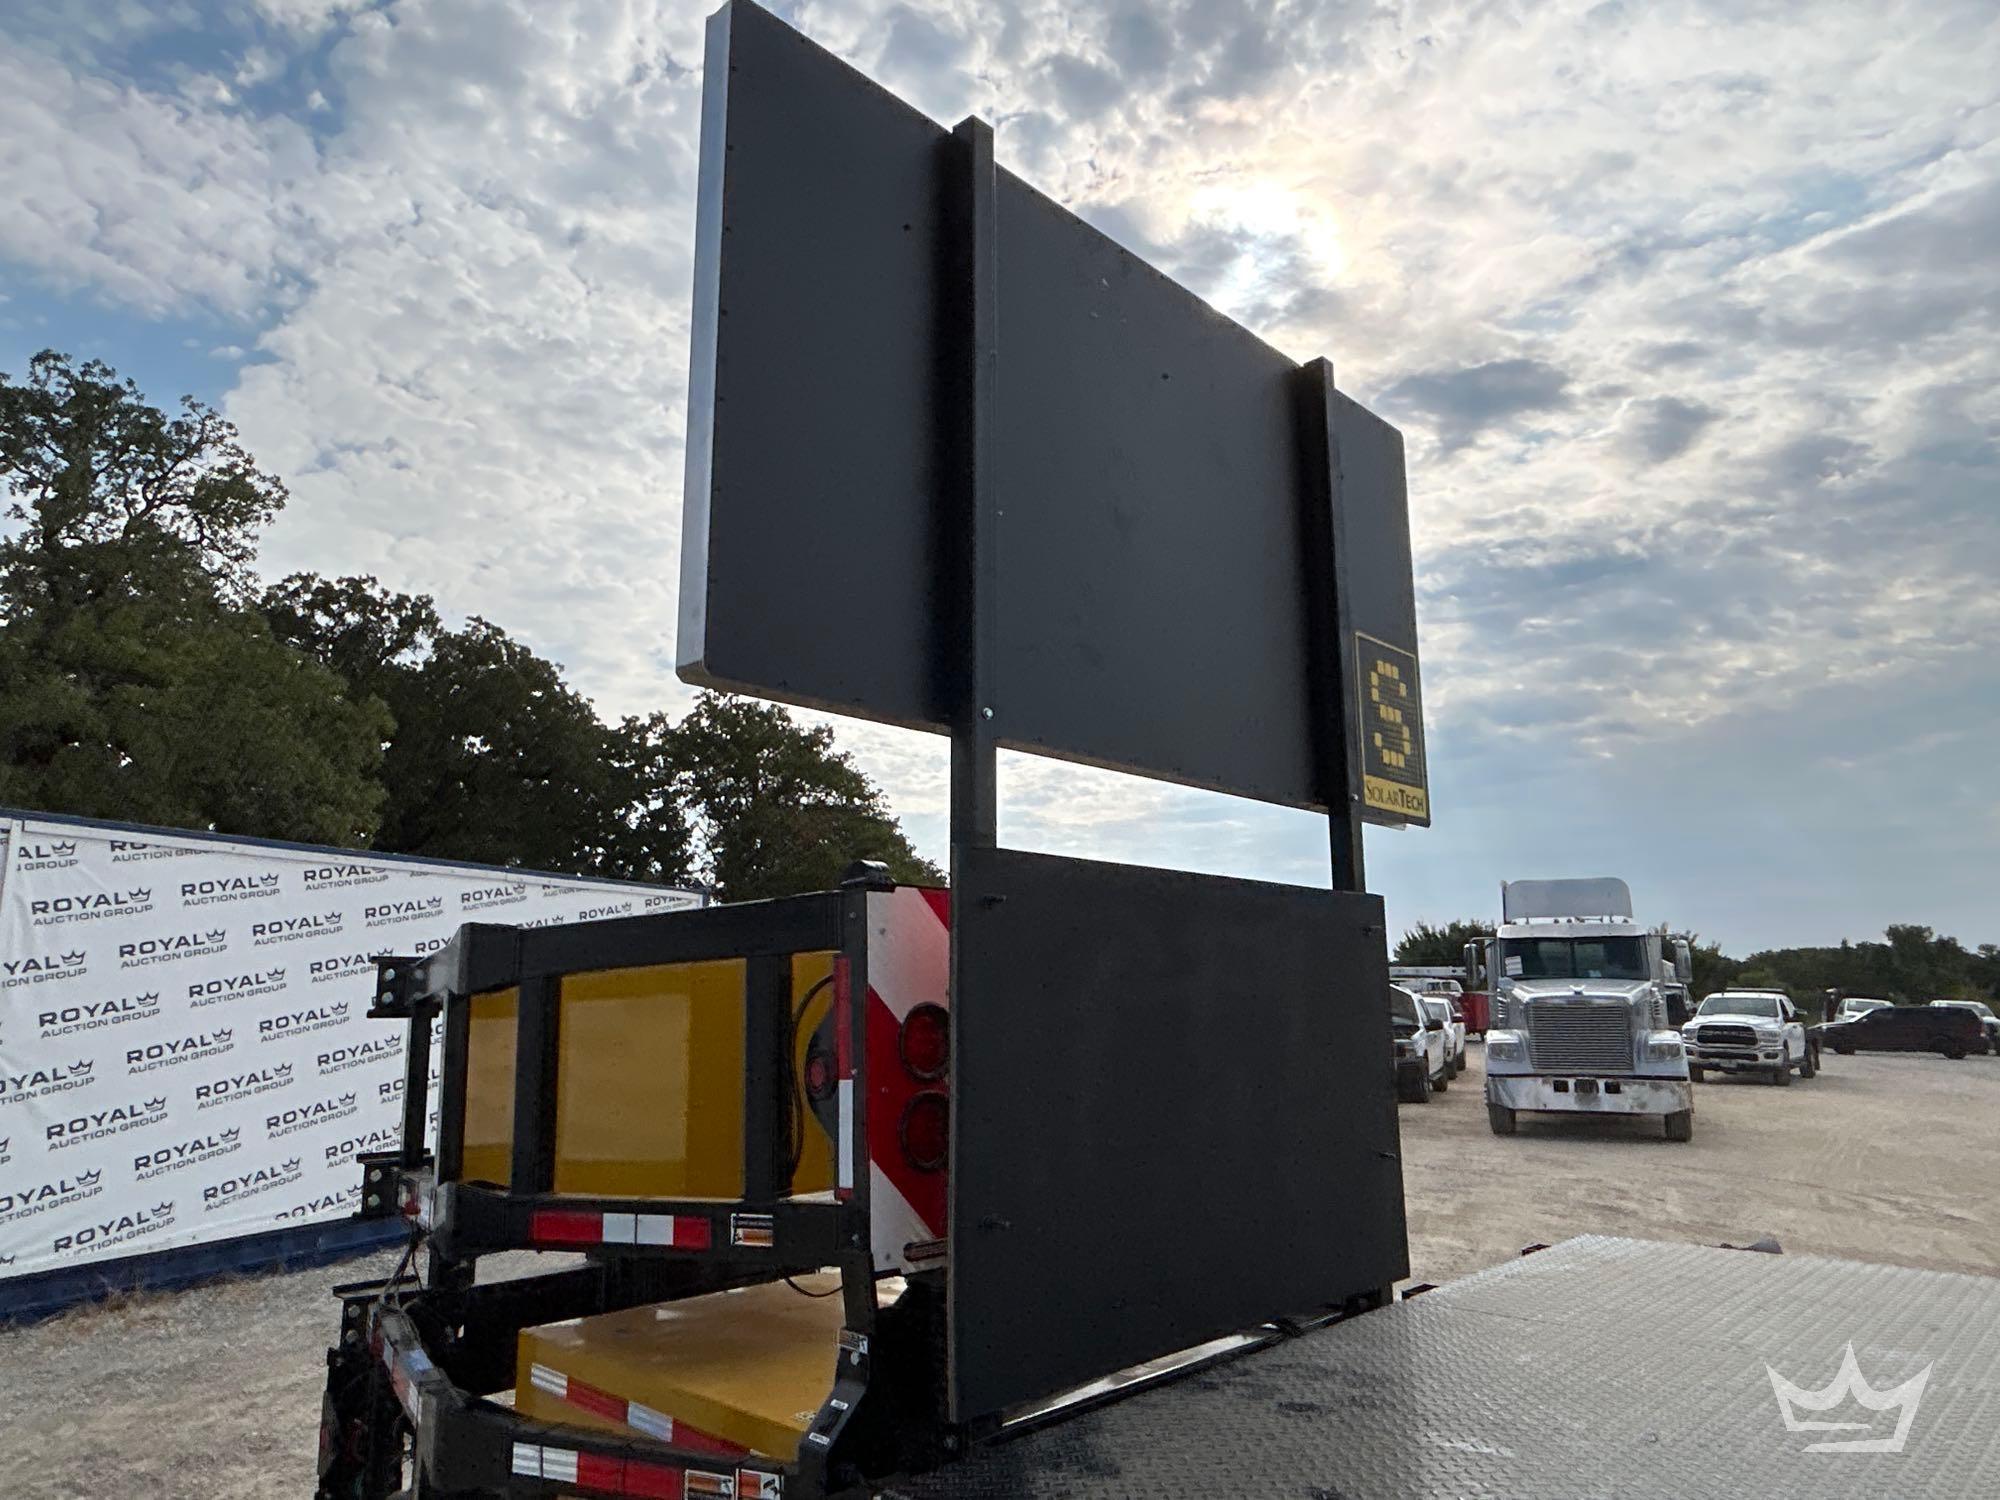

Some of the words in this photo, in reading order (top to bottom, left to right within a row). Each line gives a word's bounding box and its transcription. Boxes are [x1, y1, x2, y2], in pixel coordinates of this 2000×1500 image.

[24, 859, 79, 871] GROUP
[112, 850, 173, 863] AUCTION
[303, 865, 371, 882] ROYAL
[305, 879, 352, 891] AUCTION
[354, 875, 389, 885] GROUP
[181, 877, 259, 897] ROYAL
[183, 893, 237, 907] AUCTION
[239, 888, 280, 900] GROUP
[461, 886, 513, 903] ROYAL
[31, 892, 128, 915] ROYAL
[33, 911, 101, 926] AUCTION
[104, 904, 154, 918] GROUP
[365, 900, 426, 919] ROYAL
[462, 901, 499, 911] AUCTION
[579, 905, 621, 921] ROYAL
[252, 916, 324, 937] ROYAL
[366, 915, 409, 927] AUCTION
[411, 910, 443, 921] GROUP
[119, 934, 205, 958] ROYAL
[254, 932, 304, 946] AUCTION
[305, 925, 343, 938] GROUP
[415, 937, 451, 954] ROY
[4, 956, 59, 975] YAL
[121, 952, 181, 969] AUCTION
[183, 944, 228, 958] GROUP
[310, 952, 372, 974] ROYAL
[33, 967, 87, 983] GROUP
[188, 973, 266, 998] ROYAL
[312, 968, 358, 983] AUCTION
[190, 990, 245, 1008] AUCTION
[246, 983, 287, 997] GROUP
[39, 998, 136, 1027] ROYAL
[41, 1018, 108, 1039] AUCTION
[111, 1008, 160, 1025] GROUP
[259, 1008, 330, 1033] ROYAL
[261, 1025, 310, 1042] AUCTION
[312, 1016, 350, 1031] GROUP
[127, 1035, 212, 1064] ROYAL
[128, 1054, 188, 1075] AUCTION
[190, 1043, 234, 1060] GROUP
[317, 1040, 384, 1066] ROYAL
[319, 1059, 365, 1076] AUCTION
[367, 1048, 402, 1063] GROUP
[0, 1068, 67, 1094] YAL
[41, 1076, 95, 1095] GROUP
[196, 1069, 273, 1100] ROYAL
[198, 1088, 252, 1110] AUCTION
[254, 1077, 294, 1094] GROUP
[47, 1104, 143, 1140] ROYAL
[266, 1100, 338, 1130] ROYAL
[268, 1118, 318, 1140] AUCTION
[320, 1105, 358, 1124] GROUP
[48, 1126, 116, 1152] AUCTION
[119, 1112, 168, 1131] GROUP
[325, 1129, 392, 1159] ROYAL
[134, 1136, 219, 1171] ROYAL
[136, 1156, 196, 1181] AUCTION
[198, 1142, 242, 1162] GROUP
[0, 1180, 75, 1212] OYAL
[204, 1167, 282, 1201] ROYAL
[205, 1186, 259, 1212] AUCTION
[261, 1172, 302, 1191] GROUP
[48, 1186, 103, 1209] GROUP
[54, 1211, 149, 1252] ROYAL
[126, 1217, 175, 1239] GROUP
